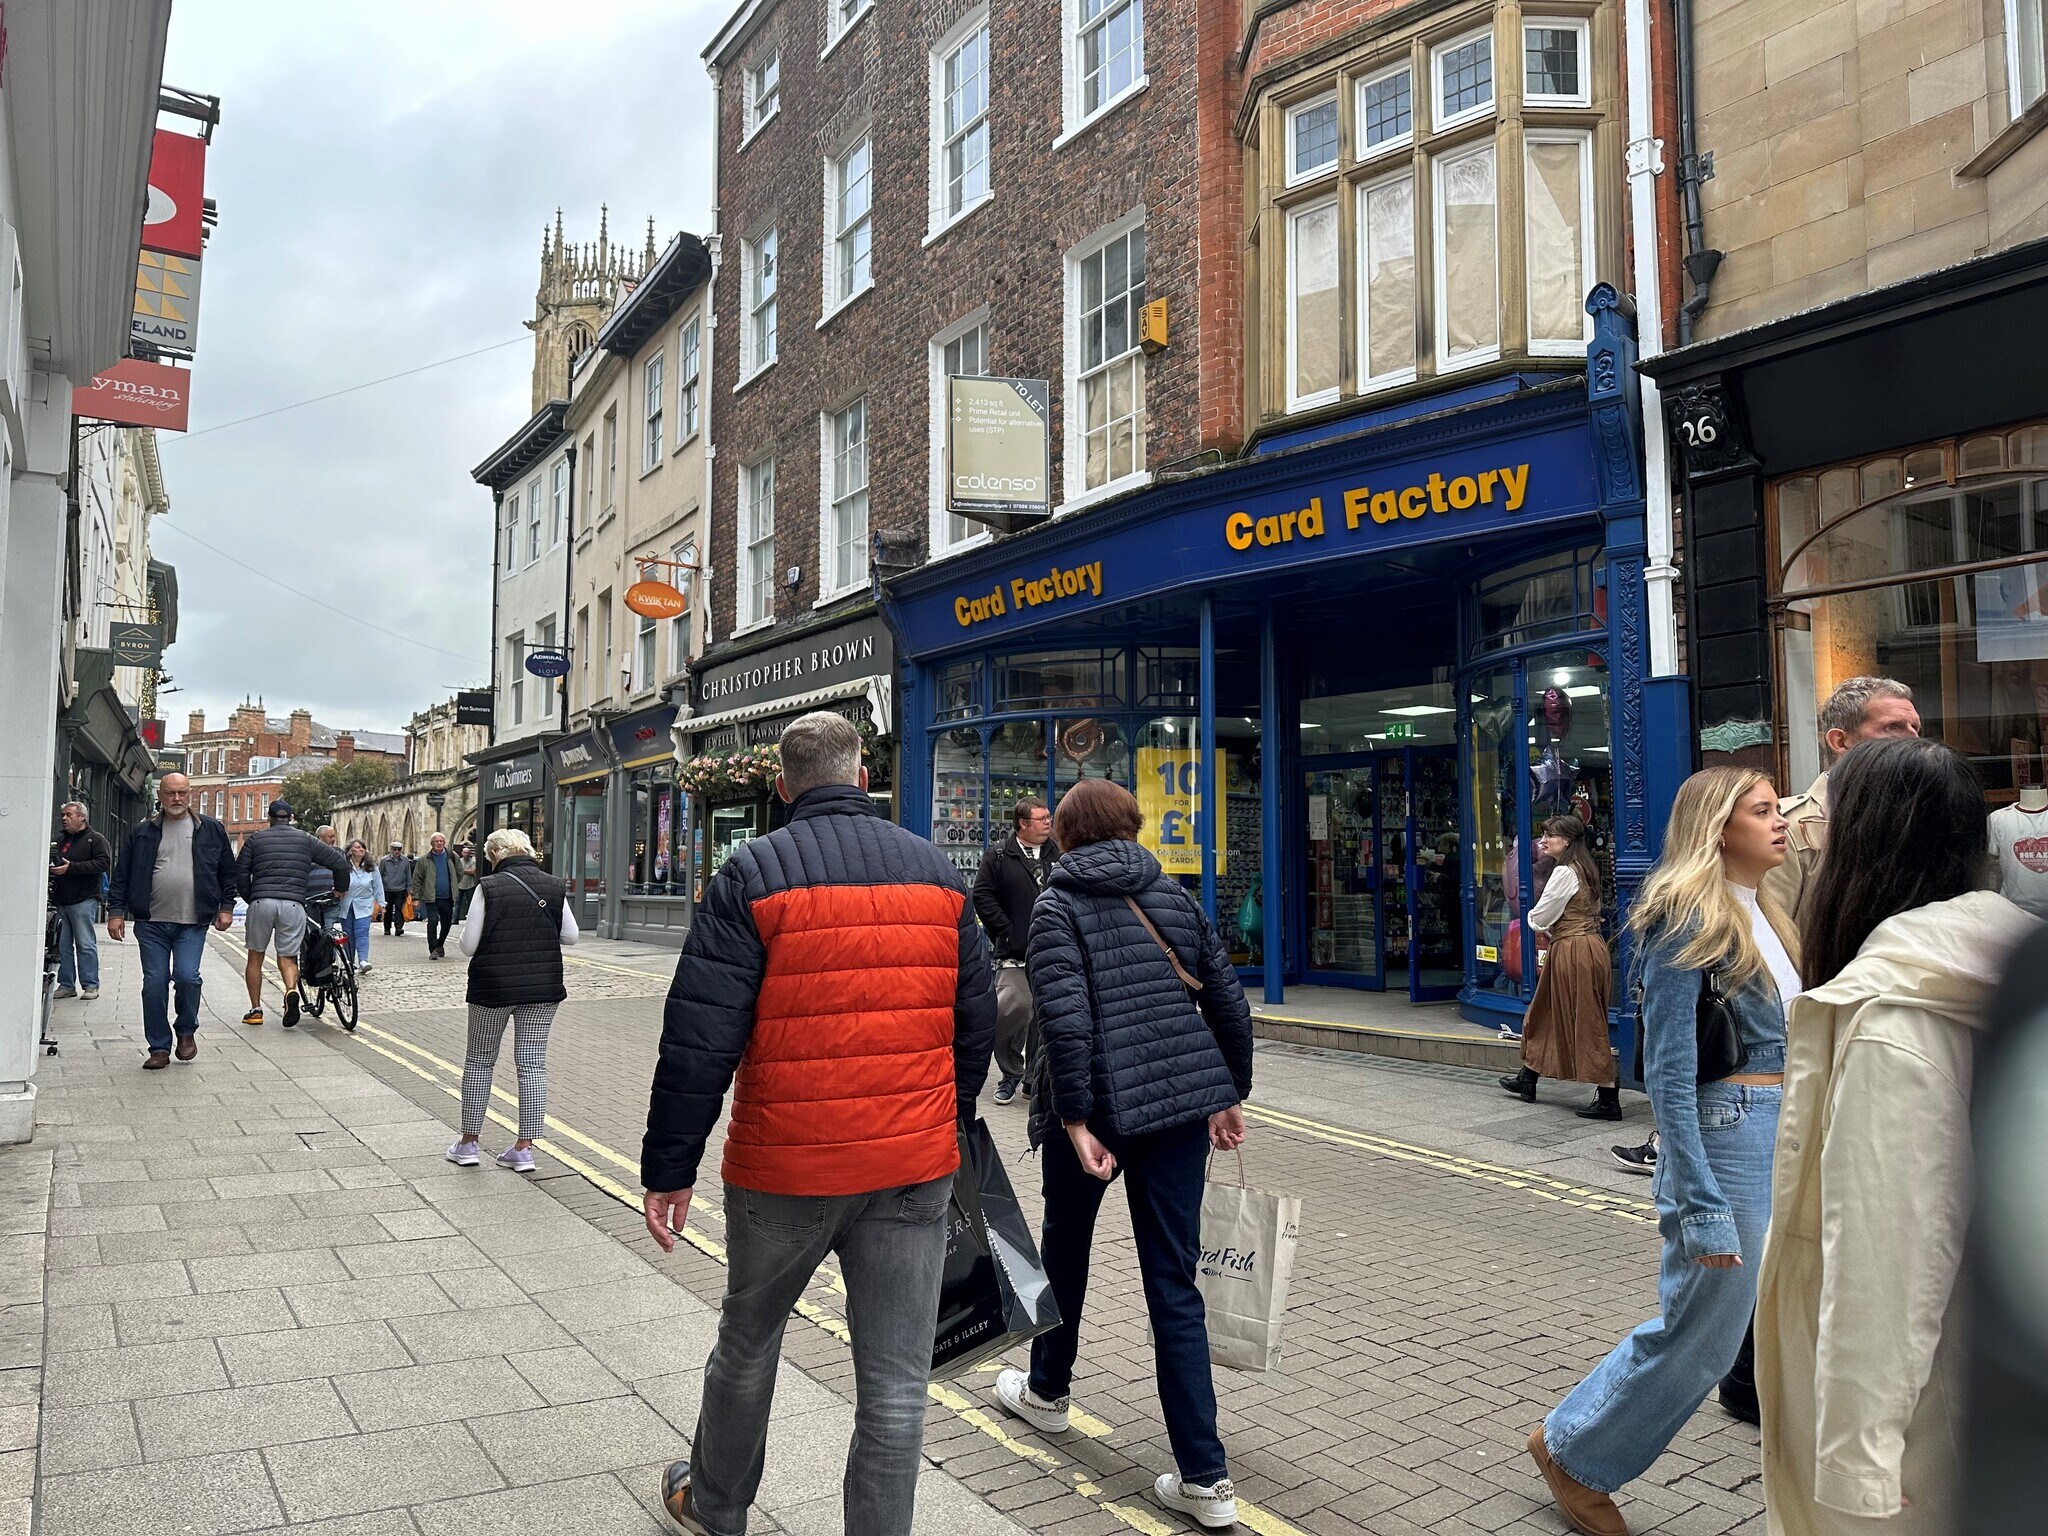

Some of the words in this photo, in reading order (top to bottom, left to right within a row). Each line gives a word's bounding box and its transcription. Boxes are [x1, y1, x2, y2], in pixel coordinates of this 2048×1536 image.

[132, 320, 187, 340] ELAND
[92, 377, 180, 400] yman
[1014, 381, 1028, 397] TO
[1025, 394, 1045, 413] LET
[113, 394, 180, 411] stationery
[968, 407, 988, 416] Prime
[989, 408, 1007, 416] Retail
[969, 398, 988, 407] 2,413
[989, 400, 998, 408] sq
[968, 416, 997, 425] Potential
[998, 417, 1007, 425] for
[1008, 418, 1043, 427] alternative
[986, 426, 1005, 435] (STP)
[1682, 415, 1717, 447] 26
[956, 472, 1037, 491] colenso
[1225, 497, 1325, 551] Card
[1343, 463, 1530, 530] Factory
[638, 594, 662, 605] KWIK
[663, 597, 681, 608] TAN
[955, 585, 1006, 627] Card
[1011, 561, 1102, 610] Factory
[120, 641, 150, 649] BYRON
[532, 654, 564, 662] ADMIRAL
[702, 657, 803, 701] CHRISTOPHER
[811, 635, 874, 673] BROWN
[469, 705, 491, 713] Summers
[493, 771, 506, 790] Ann
[505, 768, 533, 787] Summers
[1157, 761, 1202, 796] 10
[1160, 810, 1202, 845] £1
[946, 1211, 972, 1241] ERS
[1281, 1231, 1298, 1240] from
[1285, 1222, 1297, 1231] I'm
[1221, 1247, 1256, 1273] Fish
[933, 1338, 952, 1354] GATE
[953, 1334, 960, 1343] &
[961, 1319, 989, 1340] ILKLEY
